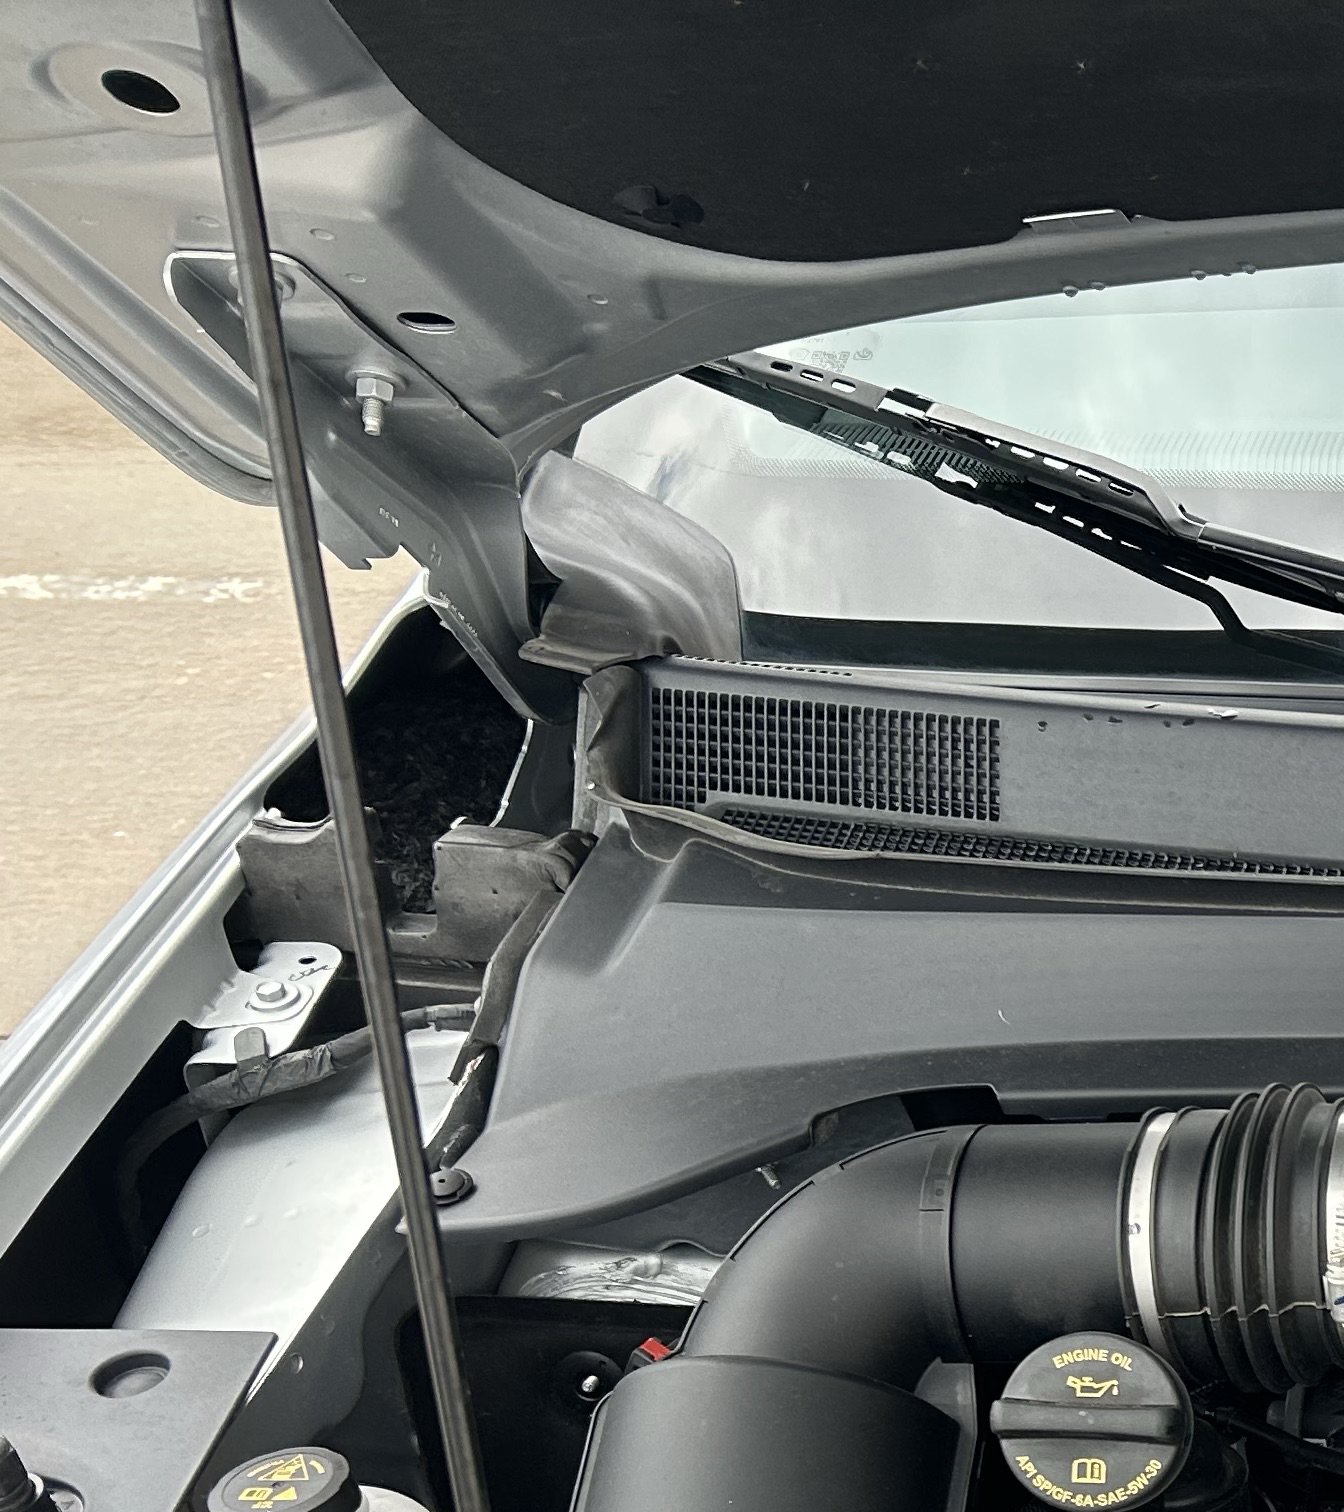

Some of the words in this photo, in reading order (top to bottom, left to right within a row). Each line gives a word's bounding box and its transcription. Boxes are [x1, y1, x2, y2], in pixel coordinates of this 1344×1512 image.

[1052, 1348, 1108, 1369] ENGINE
[1110, 1353, 1134, 1371] OIL
[1015, 1454, 1038, 1479] API
